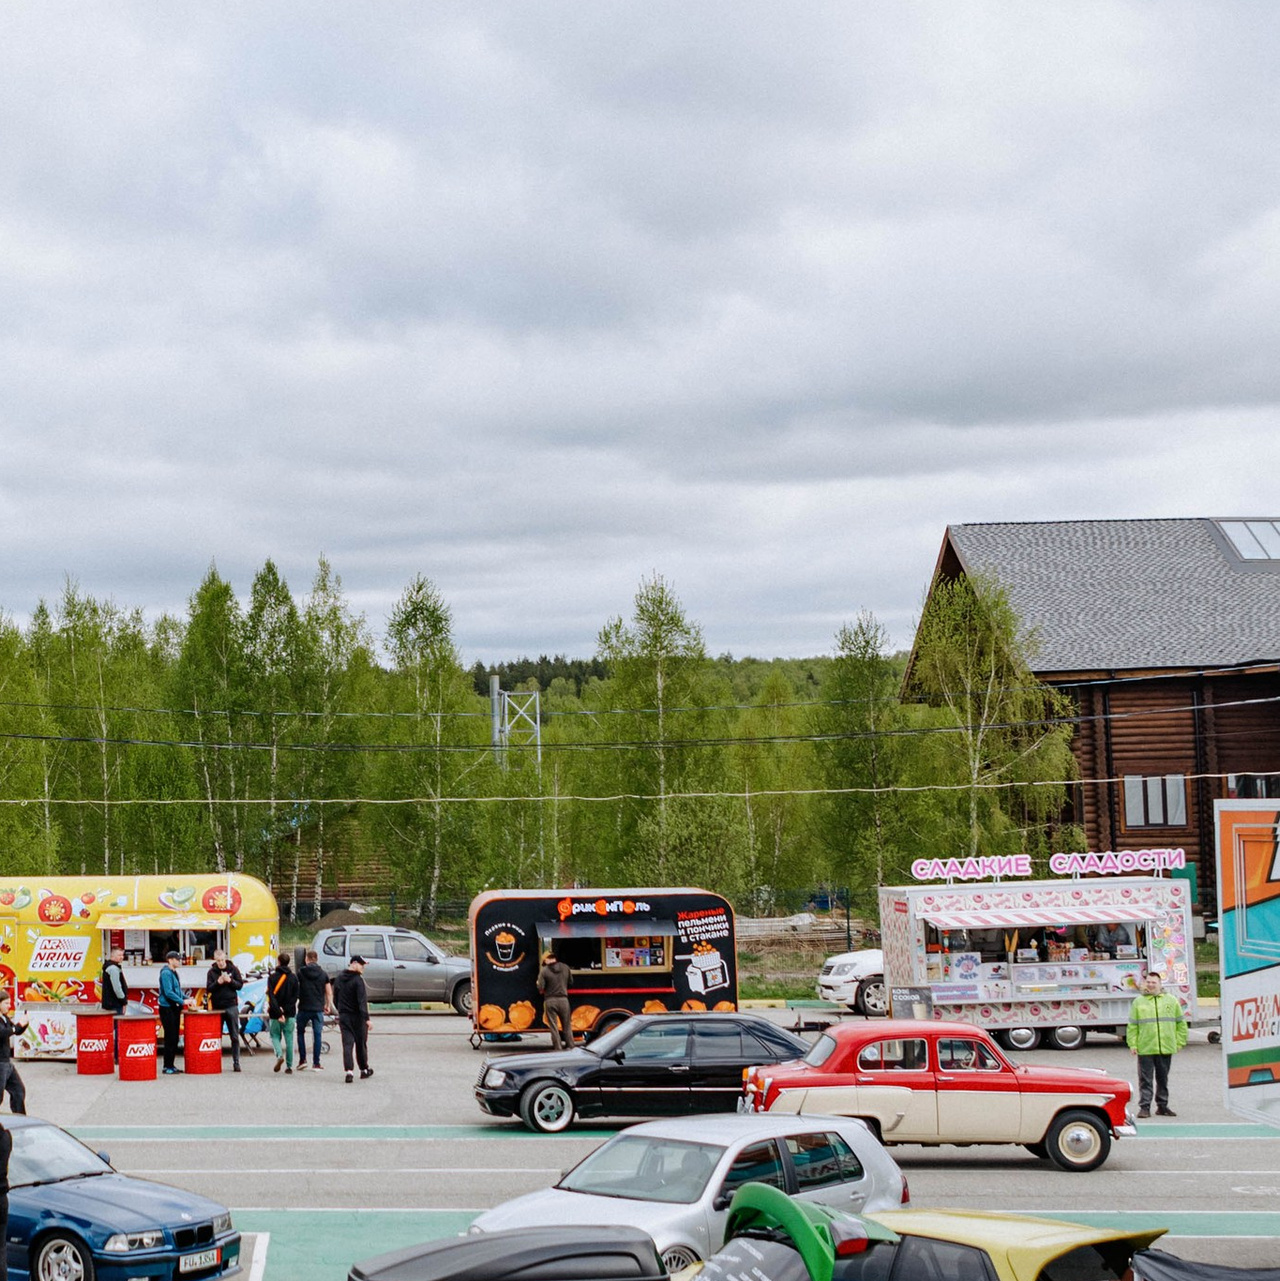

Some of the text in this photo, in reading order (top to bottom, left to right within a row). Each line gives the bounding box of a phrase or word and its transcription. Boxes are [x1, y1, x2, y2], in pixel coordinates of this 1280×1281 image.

[912, 848, 1185, 880] СЛАДКИЕ СЛАДОСТИ
[677, 907, 725, 920] Жареные
[678, 914, 727, 928] пельмени
[678, 922, 730, 936] и пончики
[689, 929, 729, 942] стакане
[34, 952, 83, 961] NRING
[1233, 999, 1257, 1039] NR
